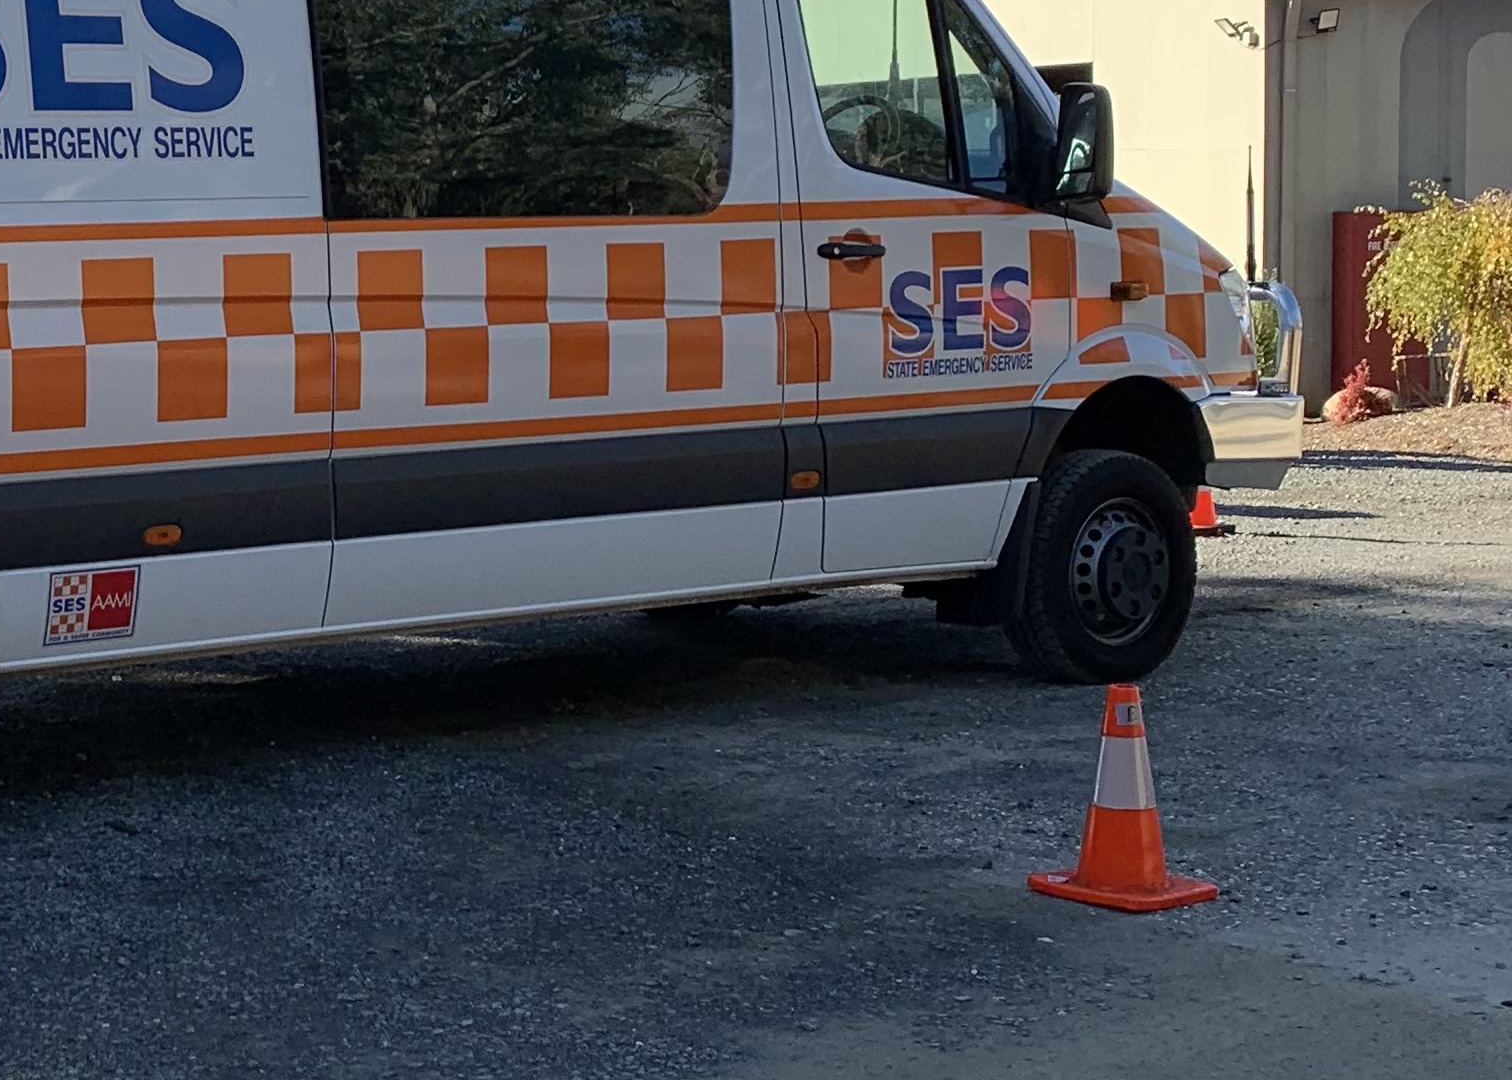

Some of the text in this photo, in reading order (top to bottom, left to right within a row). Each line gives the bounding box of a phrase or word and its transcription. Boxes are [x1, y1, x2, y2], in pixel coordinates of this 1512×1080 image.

[154, 126, 255, 158] SERVICE
[890, 266, 1032, 354] SES
[887, 353, 1033, 378] STATE EMERGENCY SERVICE
[52, 597, 86, 613] SES
[91, 591, 131, 610] AAMI
